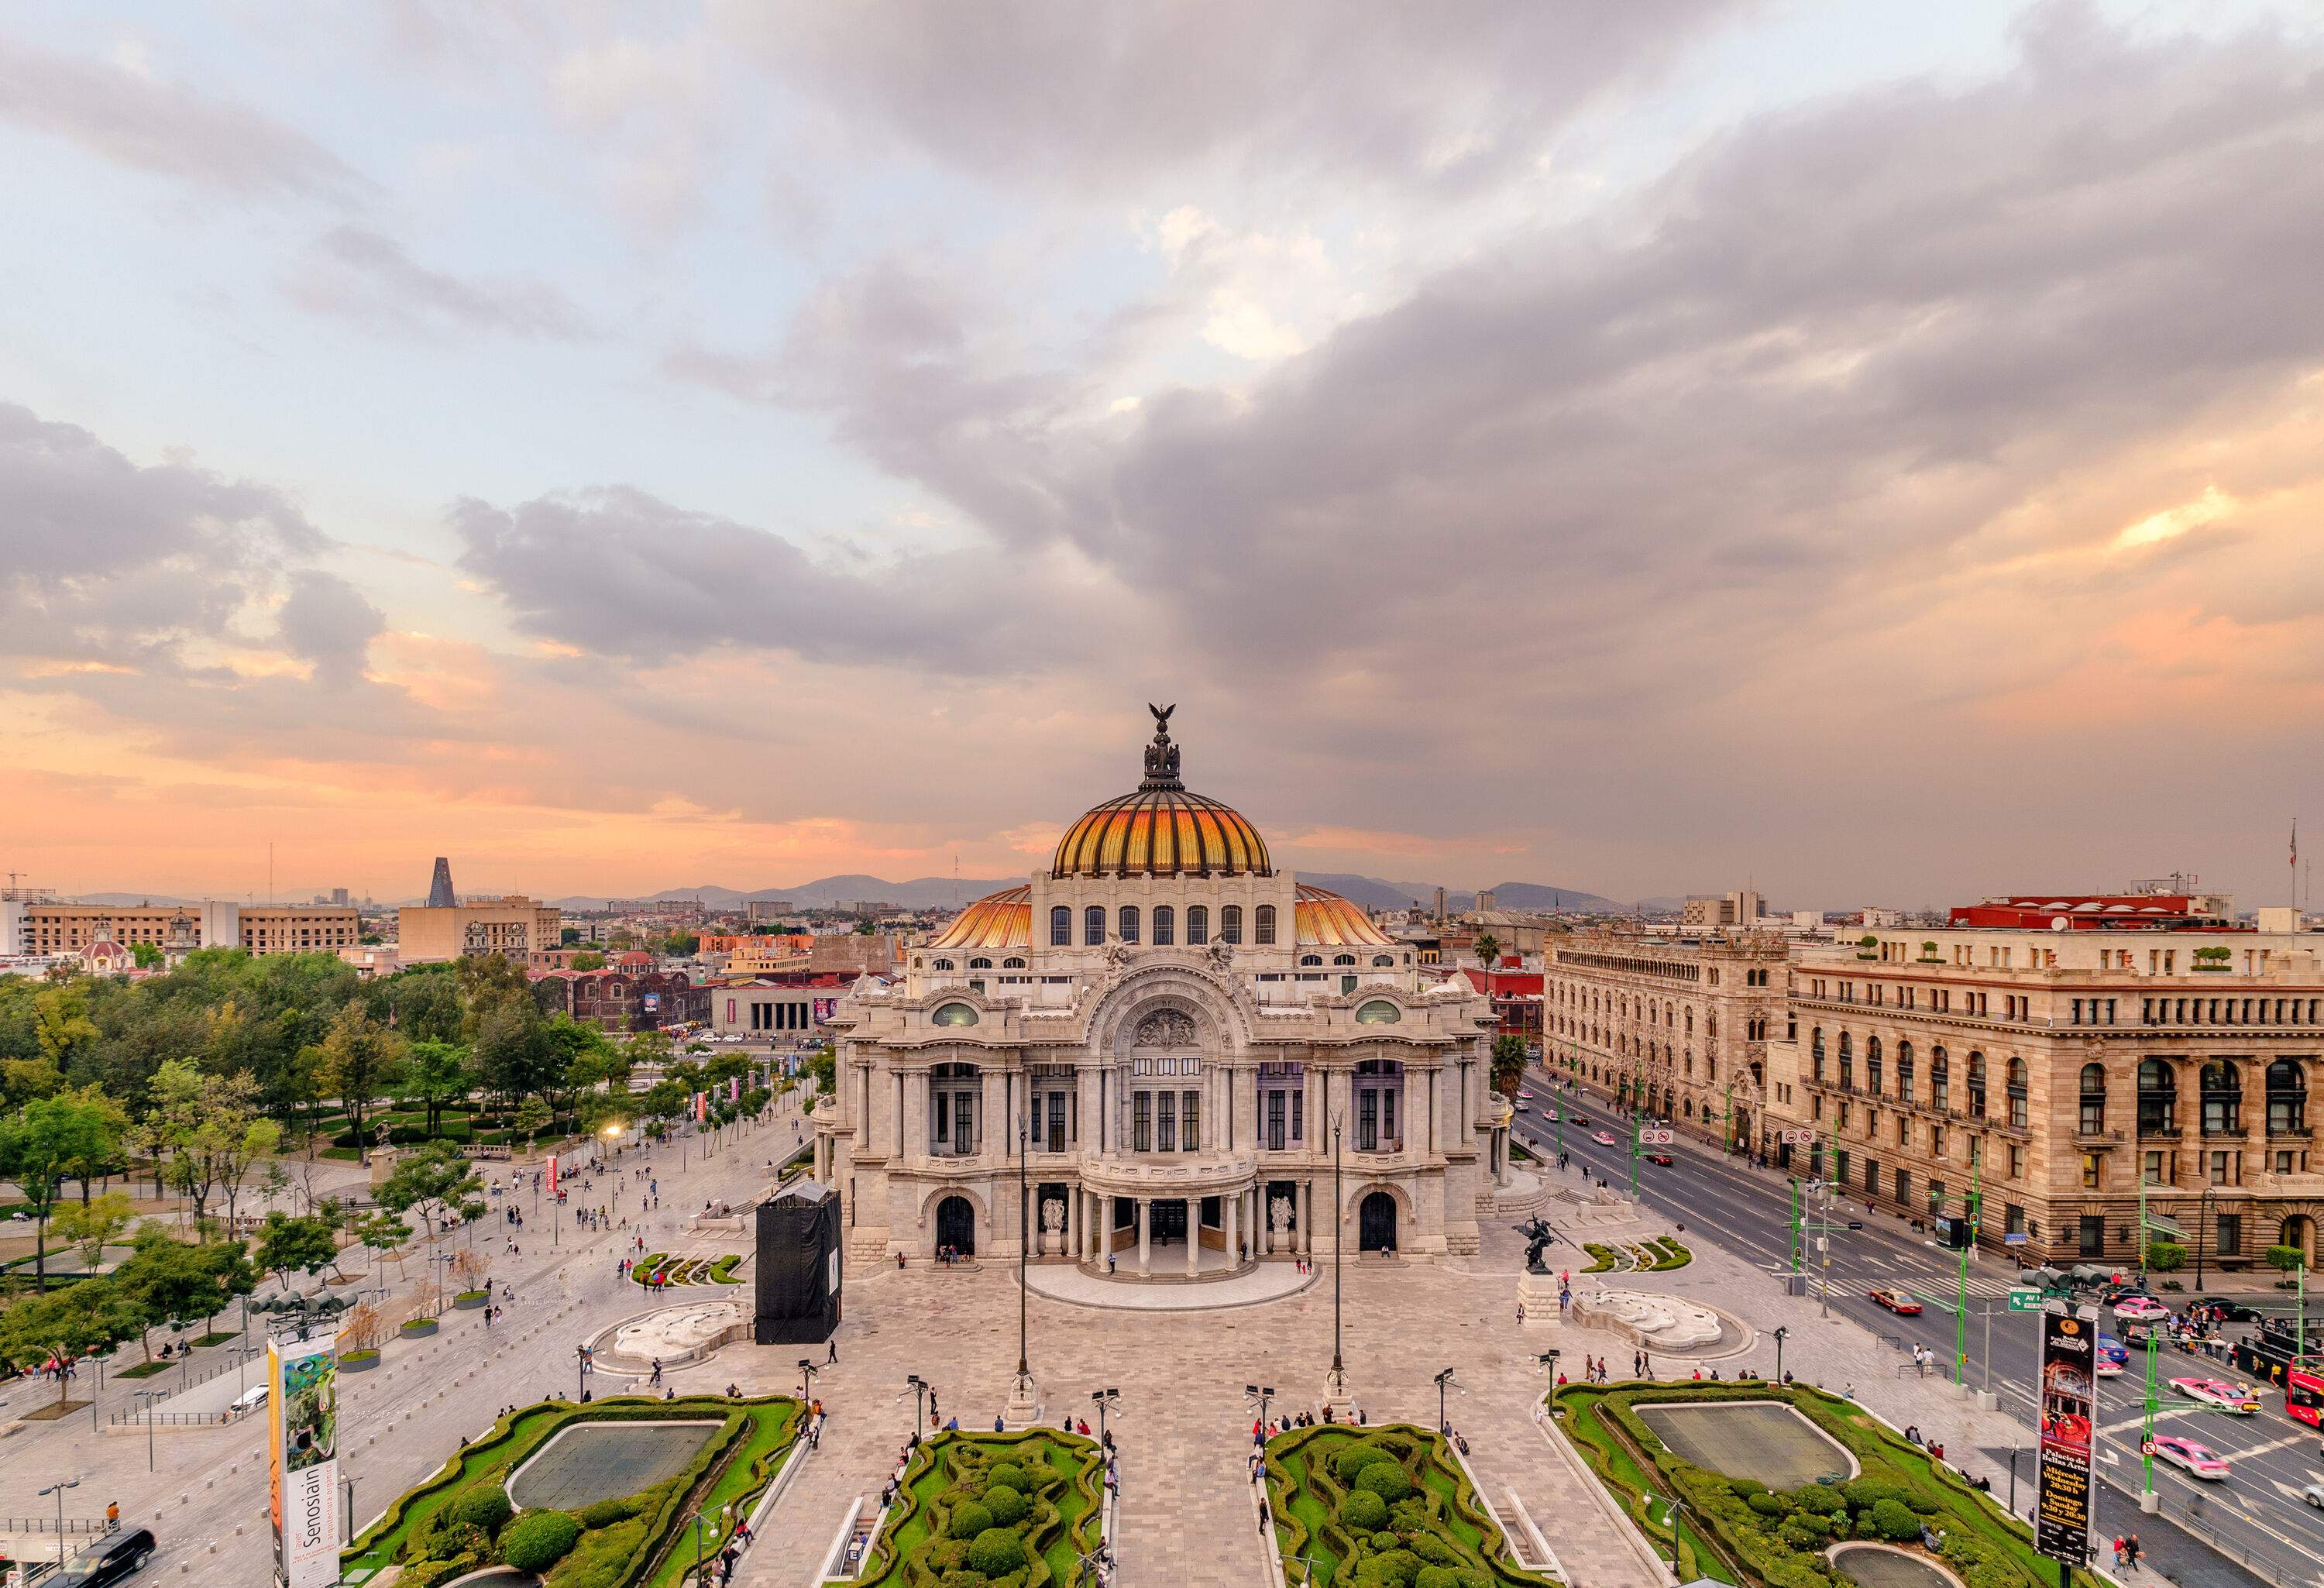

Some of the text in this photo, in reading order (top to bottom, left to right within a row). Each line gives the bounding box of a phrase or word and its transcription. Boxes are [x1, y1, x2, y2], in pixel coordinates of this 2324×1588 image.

[1122, 1000, 1212, 1044] PALACIO DE BELLAS ARTES
[2042, 1453, 2089, 1473] Bellas Artes
[2045, 1449, 2075, 1462] Palacio
[2076, 1457, 2086, 1466] de
[2043, 1471, 2087, 1490] Wednesday
[2046, 1465, 2085, 1482] Miércoles
[2051, 1480, 2072, 1493] 20:30
[2046, 1490, 2083, 1507] Domingo
[2049, 1498, 2078, 1513] Sunday
[301, 1468, 321, 1548] Senosiain
[2041, 1502, 2058, 1513] 9:30
[2064, 1510, 2086, 1521] 20:30
[850, 1550, 858, 1560] E
